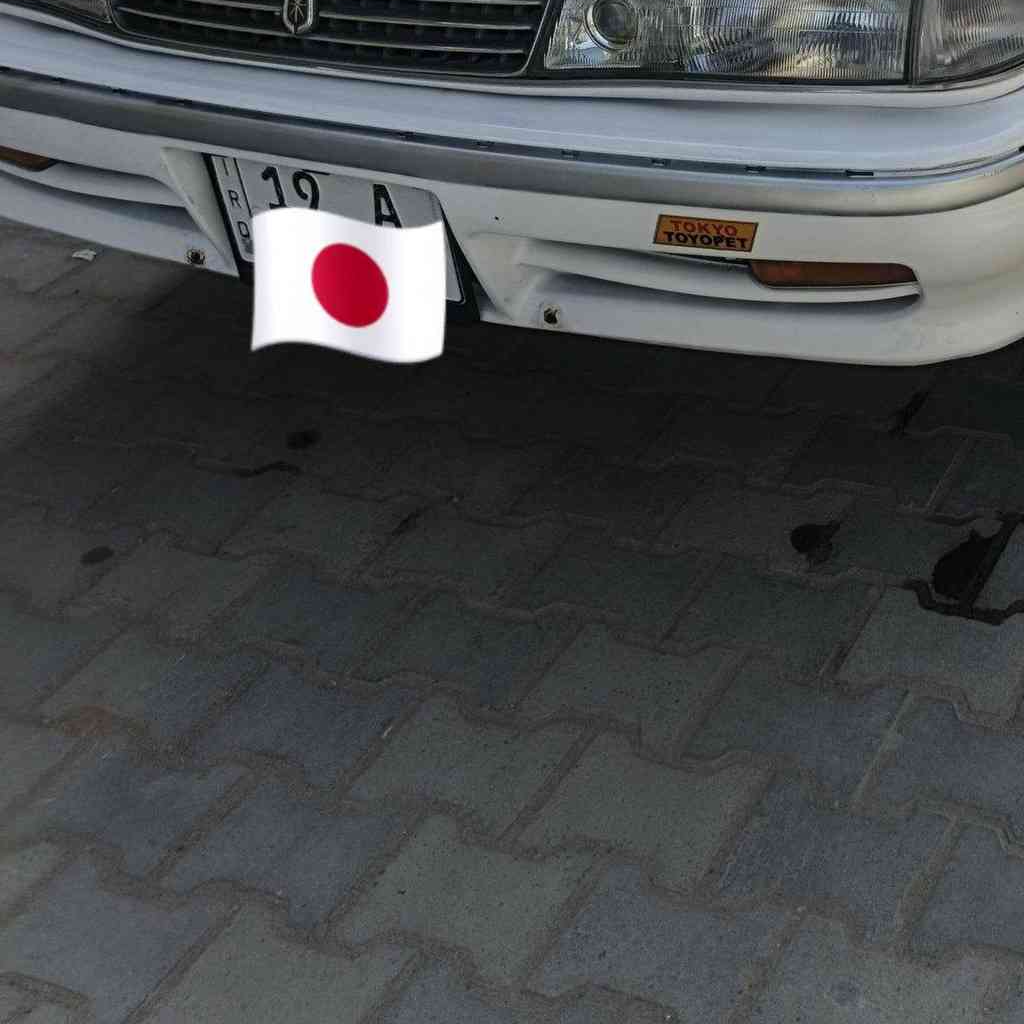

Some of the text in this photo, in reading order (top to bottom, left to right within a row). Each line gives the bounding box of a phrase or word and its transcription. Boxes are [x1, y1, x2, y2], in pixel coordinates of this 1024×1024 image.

[261, 166, 403, 228] 19 A
[670, 220, 737, 236] TOKYO
[664, 231, 747, 248] TOYOPET
